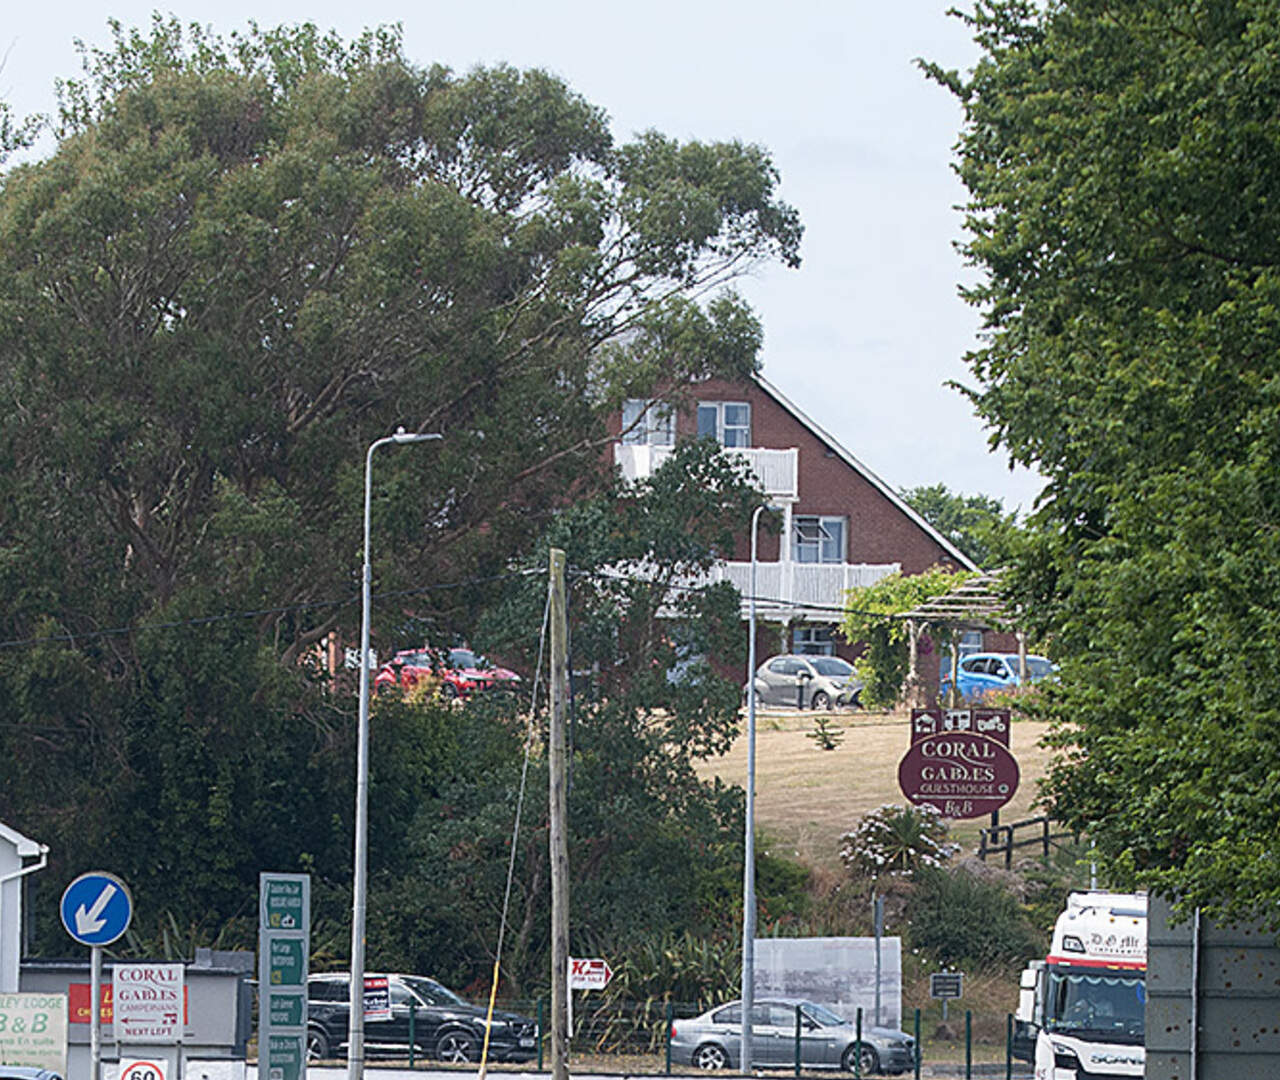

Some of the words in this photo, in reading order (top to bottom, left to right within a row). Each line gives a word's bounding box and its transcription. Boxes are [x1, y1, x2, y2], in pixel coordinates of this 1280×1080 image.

[921, 740, 996, 759] CORAL
[921, 766, 996, 783] GABLES
[919, 783, 995, 795] GUESTHOUSE
[119, 968, 178, 982] CORAL
[119, 989, 178, 1001] GABLES
[23, 996, 63, 1009] LODGE
[11, 1016, 26, 1034] &
[31, 1012, 49, 1034] B
[125, 1027, 148, 1036] NEXT
[150, 1026, 172, 1036] LEFT
